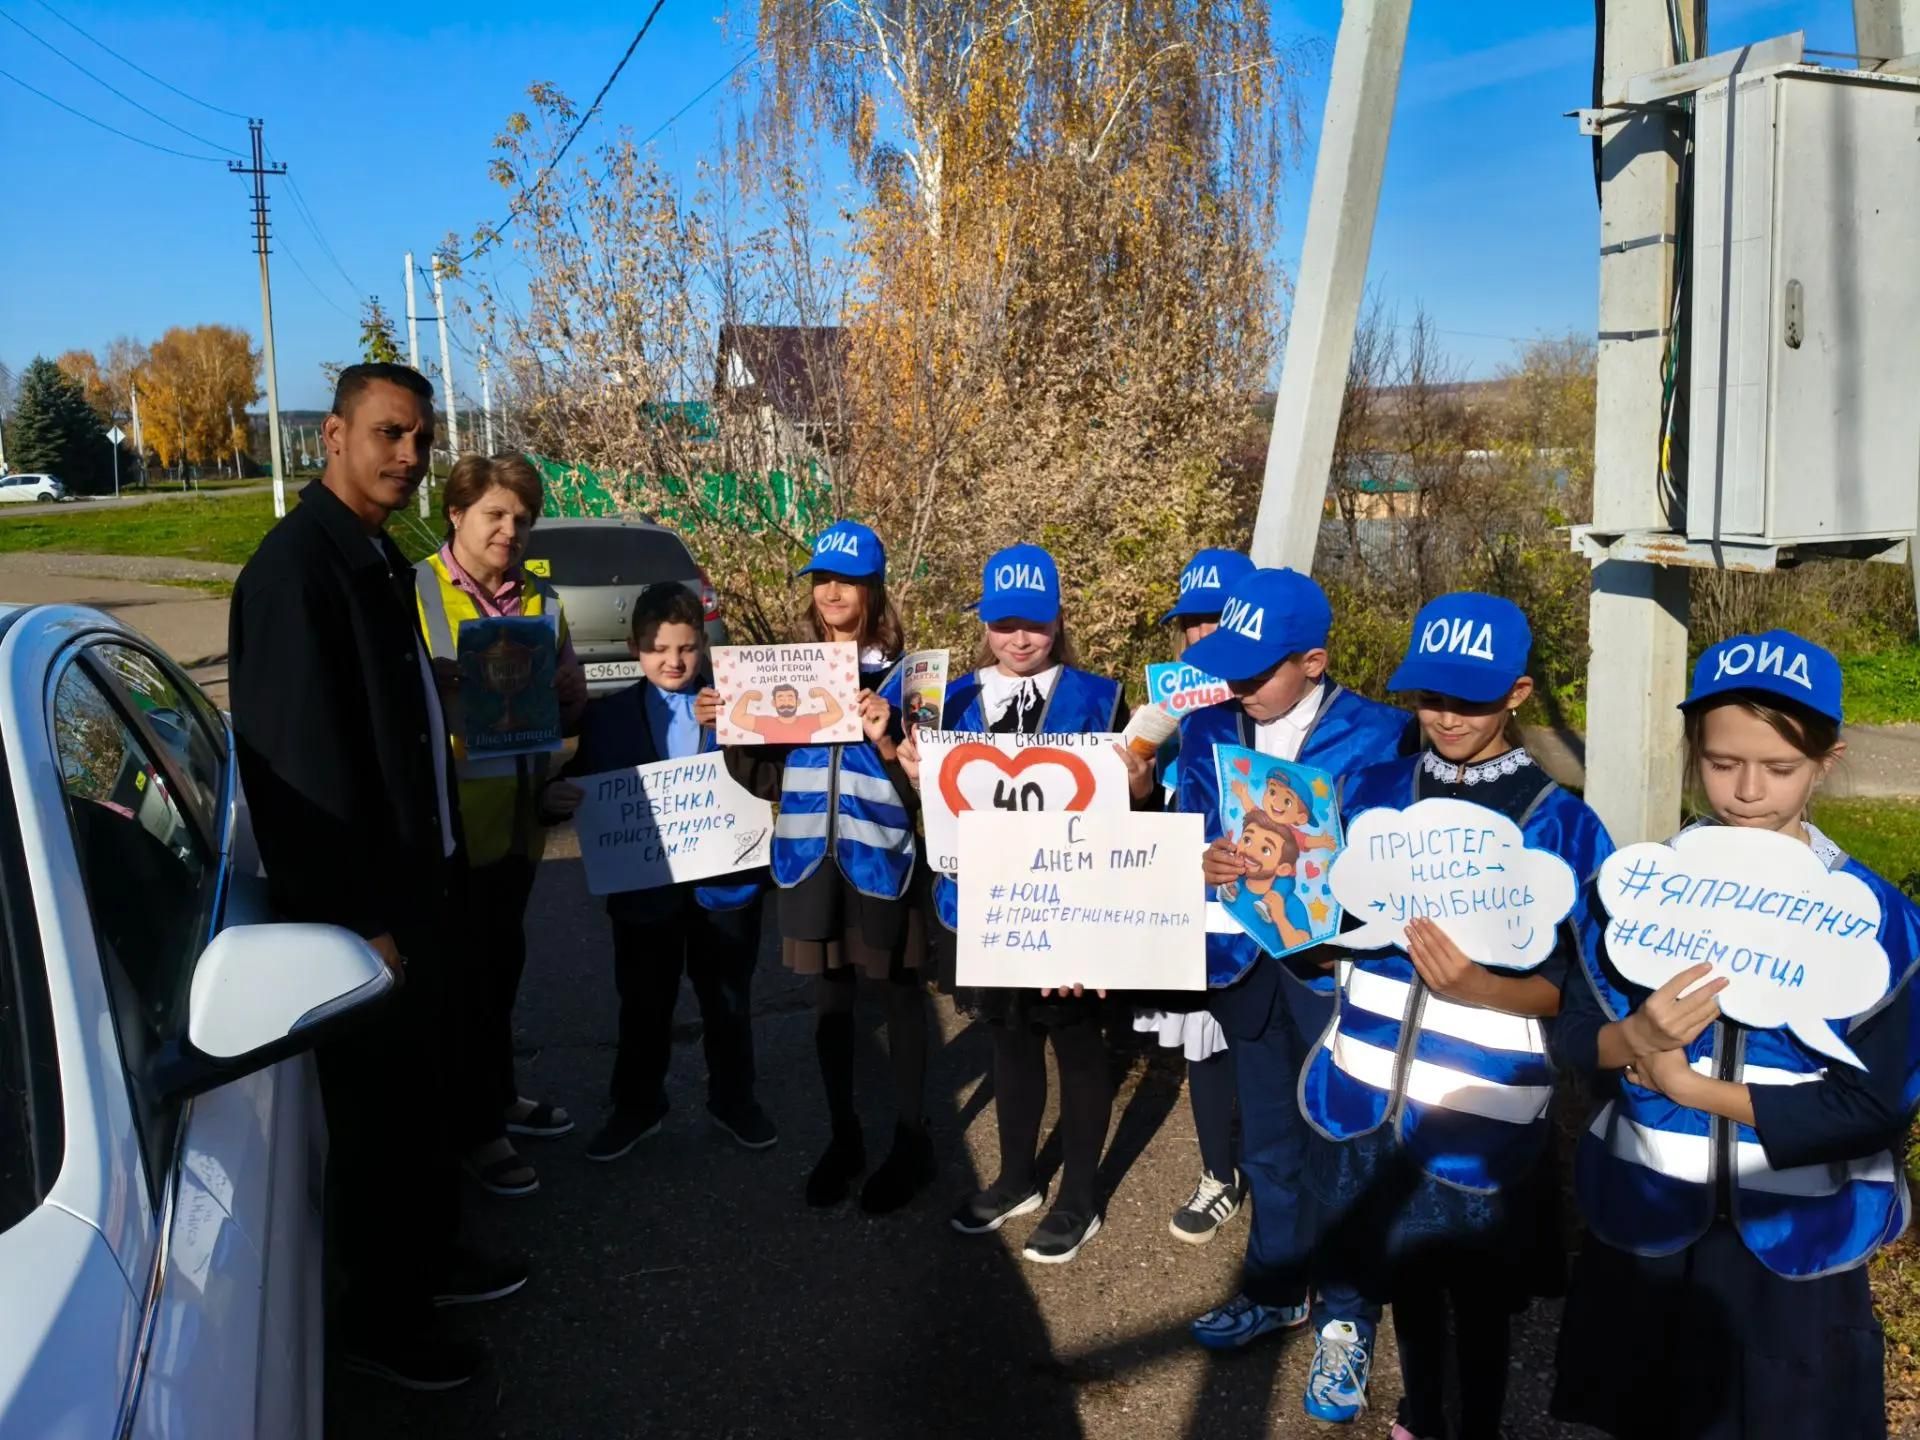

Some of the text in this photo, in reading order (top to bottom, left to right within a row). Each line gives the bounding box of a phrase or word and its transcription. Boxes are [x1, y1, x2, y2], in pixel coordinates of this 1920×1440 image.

[994, 563, 1046, 592] ЮИД
[1418, 617, 1495, 661] ЮИД
[739, 647, 825, 663] МОЙ ПАПА
[756, 661, 813, 673] МОЙ ГЕРОЙ
[1714, 640, 1813, 690] ЮИД
[750, 675, 758, 684] С
[789, 673, 819, 684] ОТЦА!
[1160, 673, 1176, 694] С
[919, 730, 996, 746] СНИЖАЕМ
[598, 763, 717, 800] ПРИСТЕГНУЛ
[993, 779, 1044, 811] 40
[599, 813, 735, 847] ПРИСТЕГНУЛСЯ
[1067, 815, 1085, 844] С
[1110, 844, 1157, 868] ПАП!
[1410, 861, 1481, 883] НИСЬ
[1389, 885, 1535, 922] УЛЫБНИСЬ
[1618, 858, 1876, 940] #ЯПРИСТЁГНУТ
